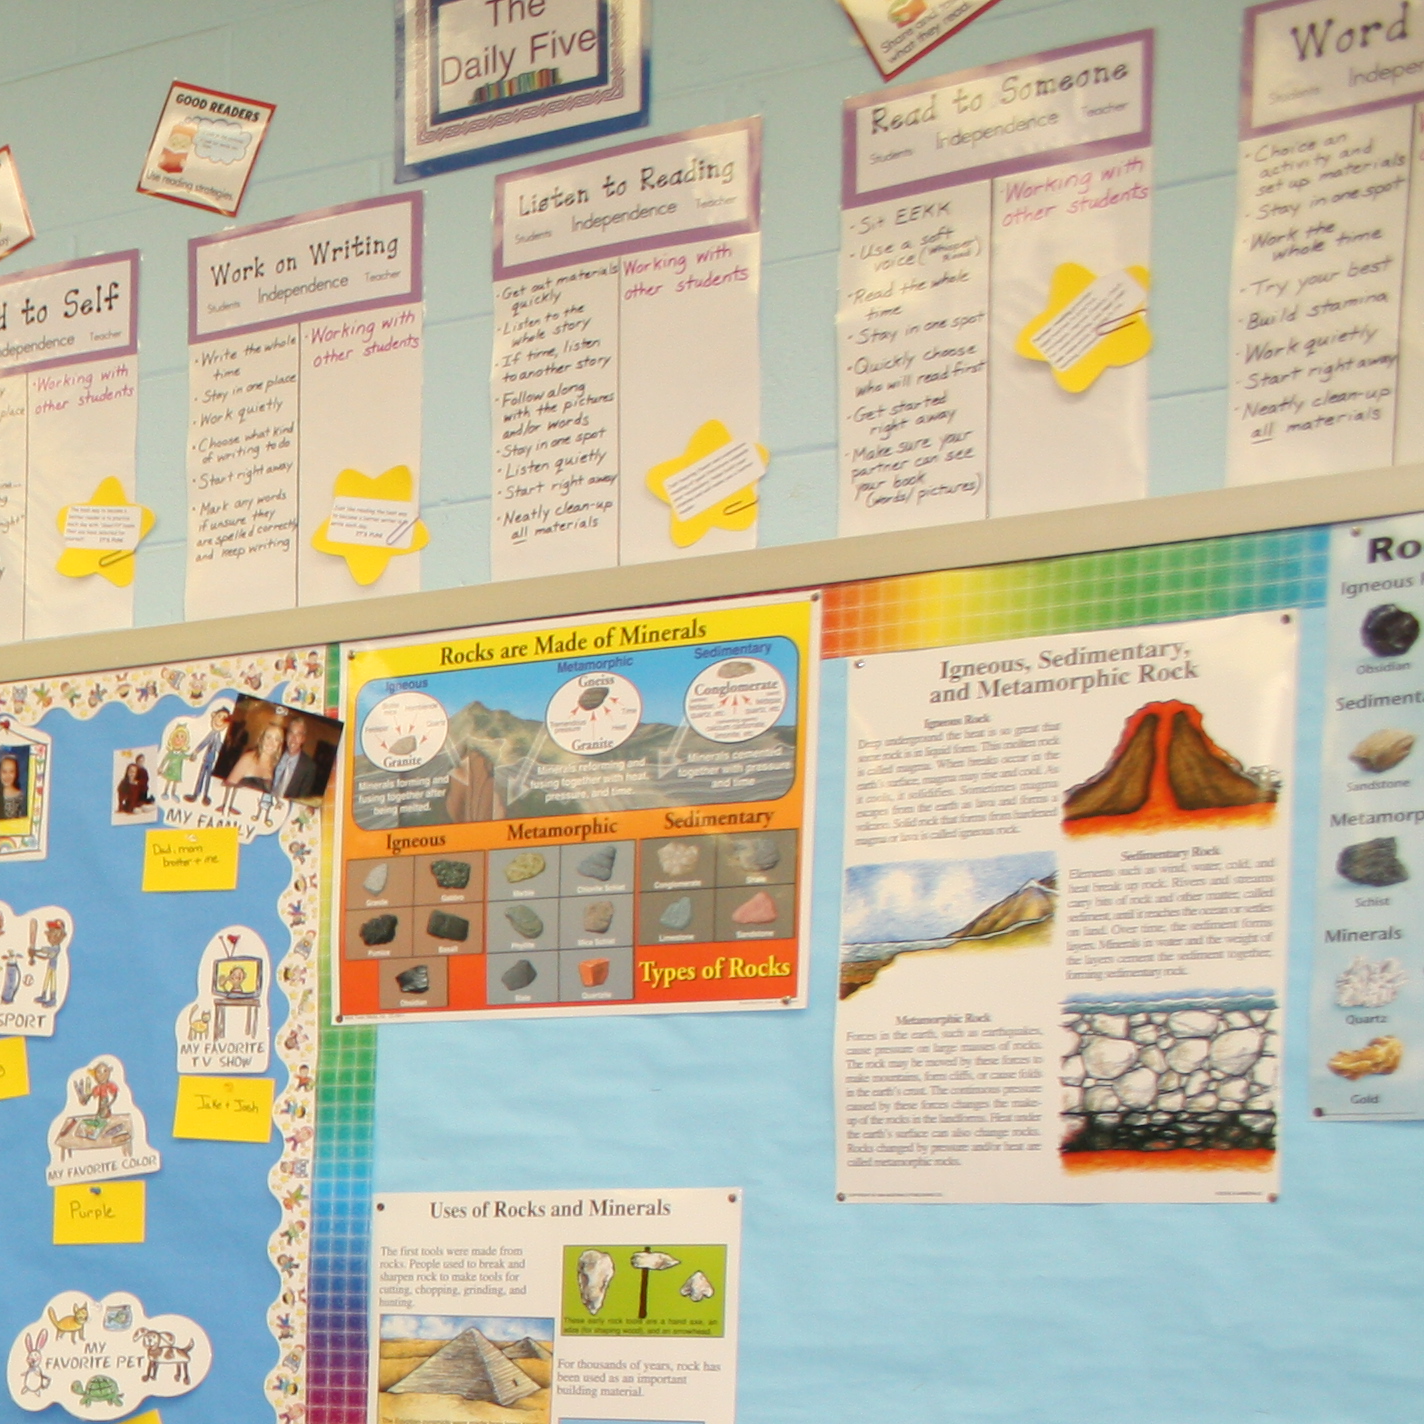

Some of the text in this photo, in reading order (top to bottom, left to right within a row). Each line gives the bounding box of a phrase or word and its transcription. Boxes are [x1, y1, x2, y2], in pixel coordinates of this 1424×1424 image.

[485, 0, 545, 27] The
[1290, 0, 1409, 61] Word
[441, 28, 597, 86] Daily Five
[175, 93, 261, 123] GOOD READERS
[871, 61, 1129, 135] Read to Someone
[936, 112, 1059, 150] Independence
[145, 167, 162, 184] Use
[162, 173, 194, 193] reading
[518, 158, 735, 217] Listen to Reading
[571, 201, 678, 234] Independence
[210, 234, 399, 287] Work on Writing
[257, 268, 401, 304] Independence Teacher
[21, 298, 48, 326] to
[63, 281, 119, 318] Self
[89, 329, 122, 342] Teacher
[311, 309, 415, 344] Working with
[313, 334, 420, 368] other students
[1341, 576, 1413, 599] Igneous
[439, 619, 707, 666] Rocks are Made of Minerals
[694, 642, 773, 660] Sedimentary
[557, 656, 634, 673] Metamorphic
[938, 641, 1192, 682] Igneous, Sedimentary,
[1356, 661, 1410, 675] Obsidian
[385, 677, 428, 694] Igneous
[578, 674, 616, 687] Gneiss
[693, 680, 780, 698] Conglomerate
[929, 661, 1199, 703] and Metamorphic Rock
[571, 737, 615, 751] Granite
[383, 754, 423, 769] Granite
[1347, 778, 1410, 792] Sandstone
[166, 809, 191, 826] MY
[386, 808, 776, 851] Igneous Metamorphic Sedimentary
[1354, 897, 1390, 908] Schist
[1325, 926, 1402, 943] Minerals
[638, 954, 792, 988] Types of Rocks
[1346, 1014, 1388, 1026] Quartz
[180, 1041, 265, 1055] MY FAVORITE
[191, 1057, 253, 1069] TV SHOW
[1350, 1094, 1379, 1106] Gold
[47, 1155, 158, 1182] MY FAVORITE COLOR
[70, 1201, 116, 1220] Purple
[429, 1198, 672, 1218] Uses of Rocks and Minerals
[84, 1342, 106, 1354] MY
[45, 1355, 145, 1370] FAVORITE PET
[557, 1359, 721, 1373] For thousands of years, rock has
